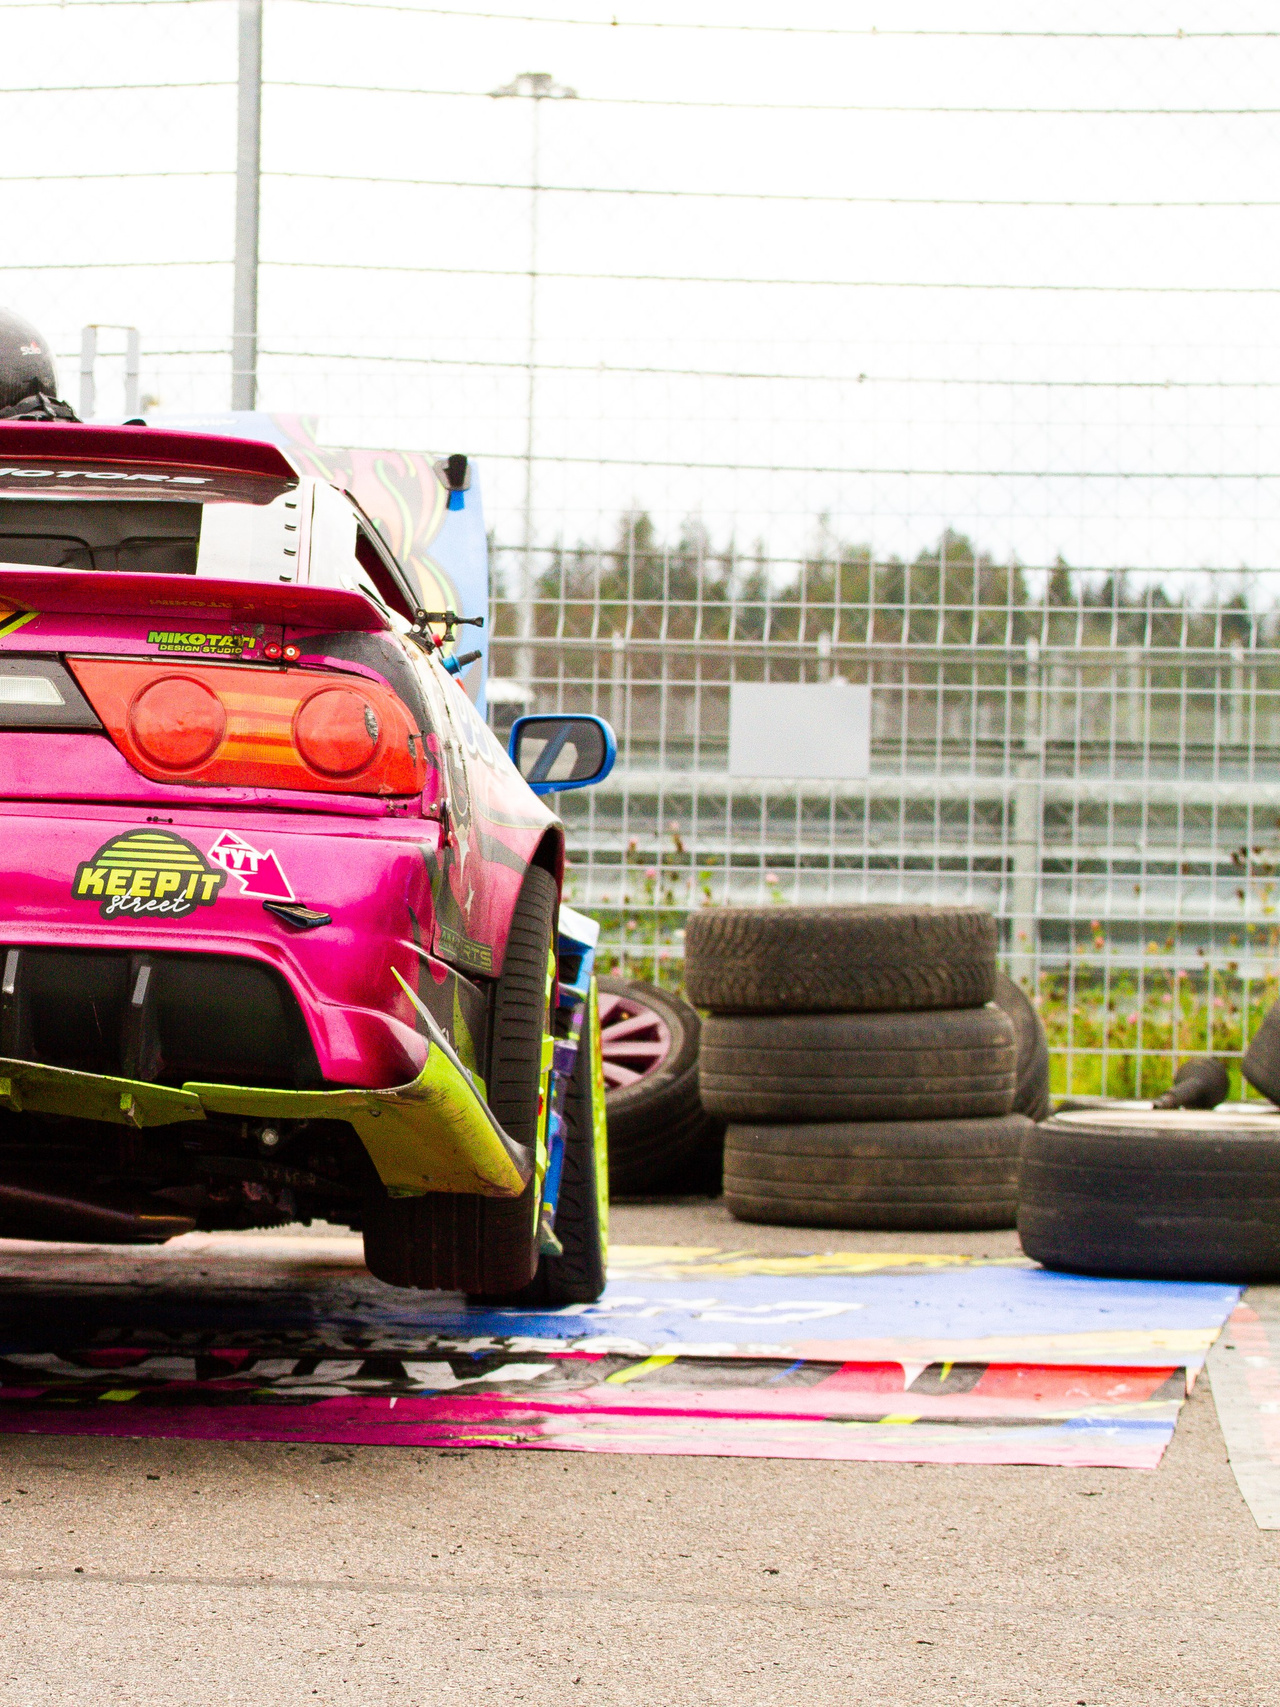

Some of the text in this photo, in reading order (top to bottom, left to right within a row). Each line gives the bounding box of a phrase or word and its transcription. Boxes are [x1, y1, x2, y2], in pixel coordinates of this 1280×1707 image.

[160, 644, 243, 654] DESIGN STUDIO
[77, 867, 221, 900] KEEP IT
[105, 887, 192, 914] street
